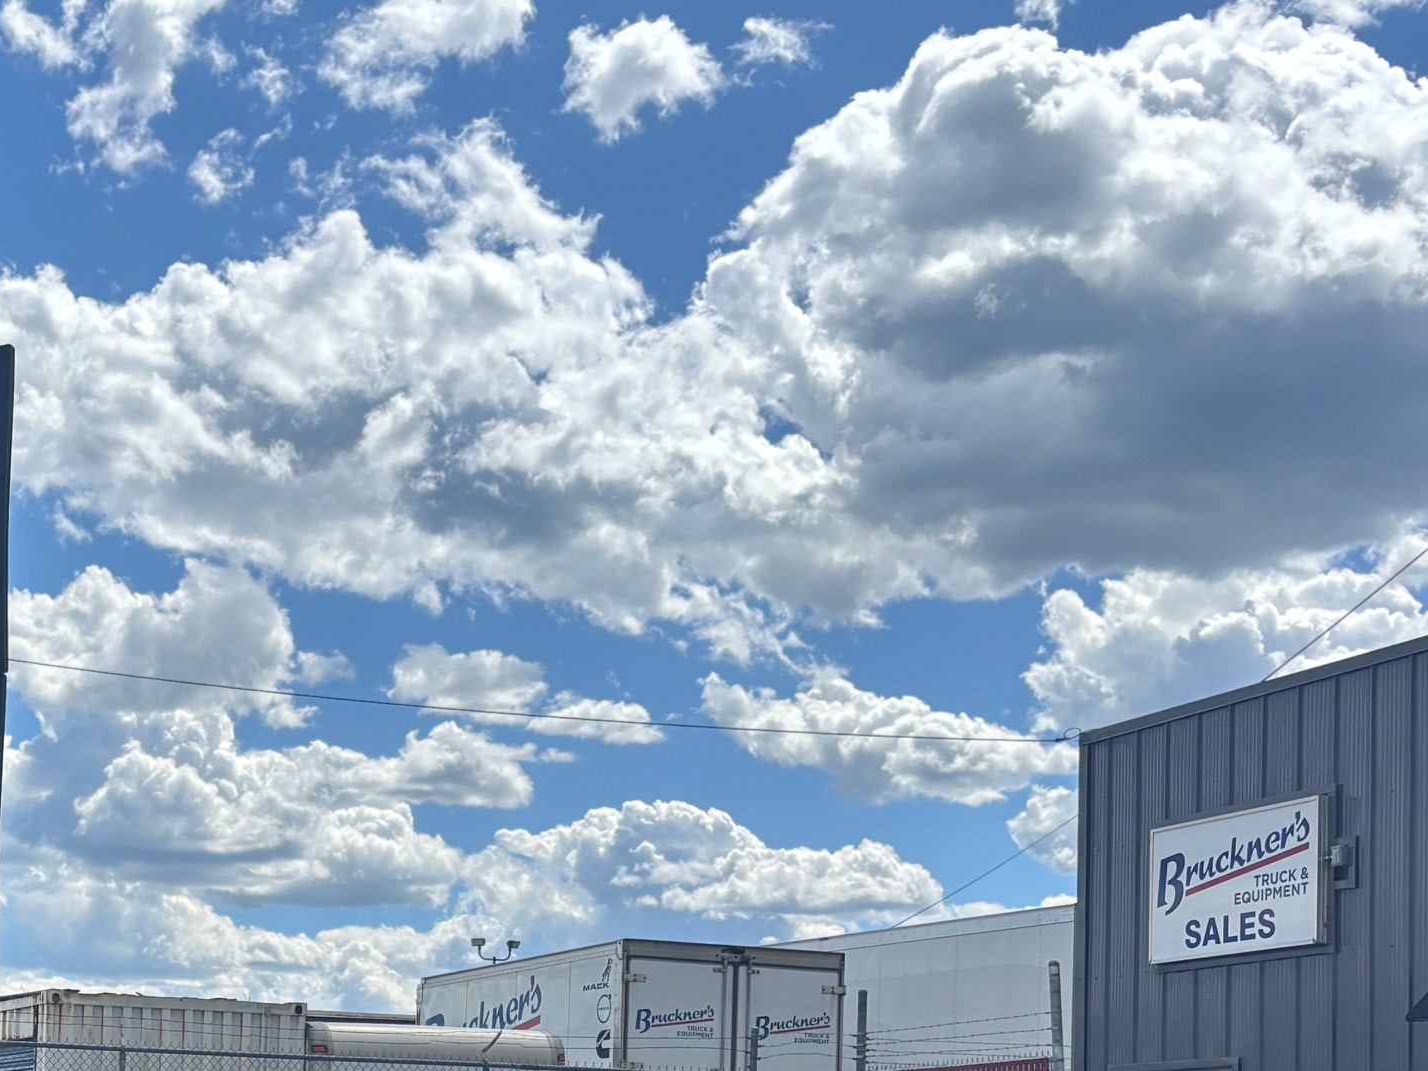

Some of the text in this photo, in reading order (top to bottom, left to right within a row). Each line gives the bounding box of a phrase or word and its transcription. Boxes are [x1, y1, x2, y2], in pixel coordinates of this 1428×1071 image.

[1156, 810, 1310, 917] Bruckner's
[1253, 866, 1309, 888] TRUCK &
[1233, 882, 1310, 906] EQUIPMENT
[1184, 908, 1276, 949] SALES
[582, 982, 609, 992] MACK
[634, 1005, 715, 1034] Bruckner's
[755, 1012, 831, 1041] Bruckner's
[676, 1031, 714, 1039] EQUIPMENT
[794, 1037, 830, 1045] EQUIPMENT
